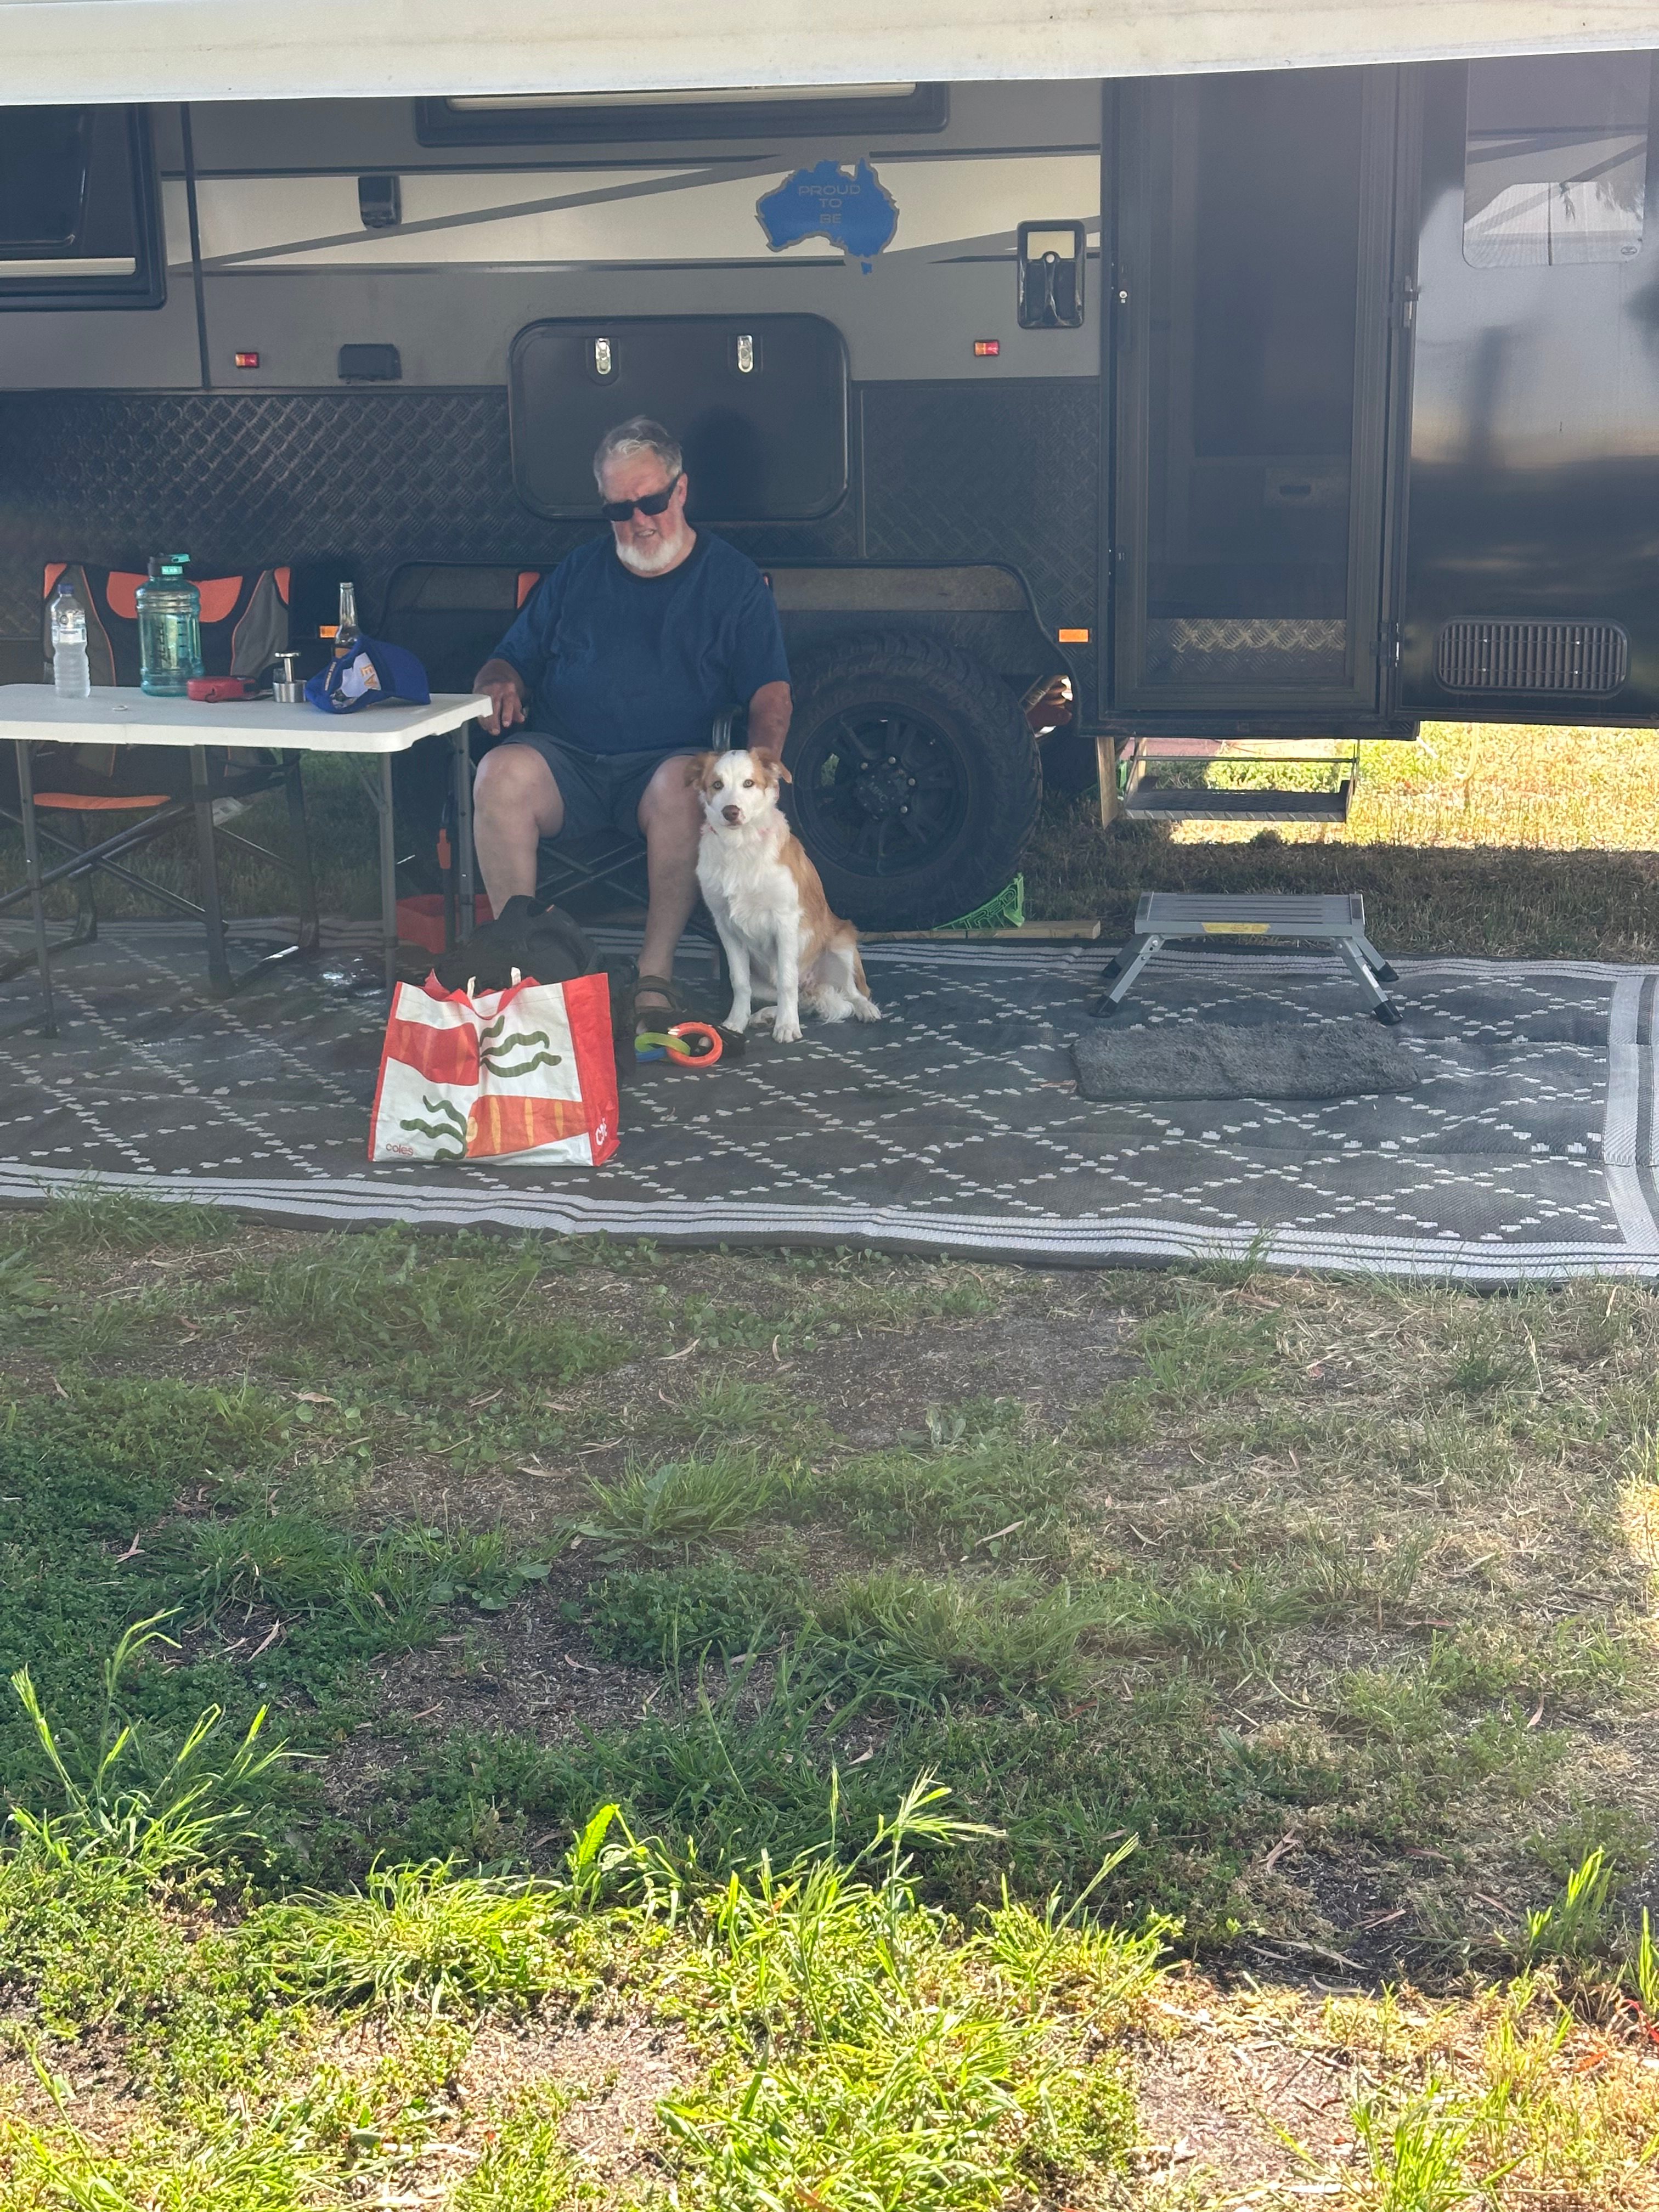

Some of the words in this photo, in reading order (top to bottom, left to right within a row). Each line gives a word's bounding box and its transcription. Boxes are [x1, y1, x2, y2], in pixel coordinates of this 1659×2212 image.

[798, 185, 861, 196] PROUD
[819, 198, 842, 208] TO
[820, 213, 842, 223] BE
[386, 1143, 414, 1156] coles
